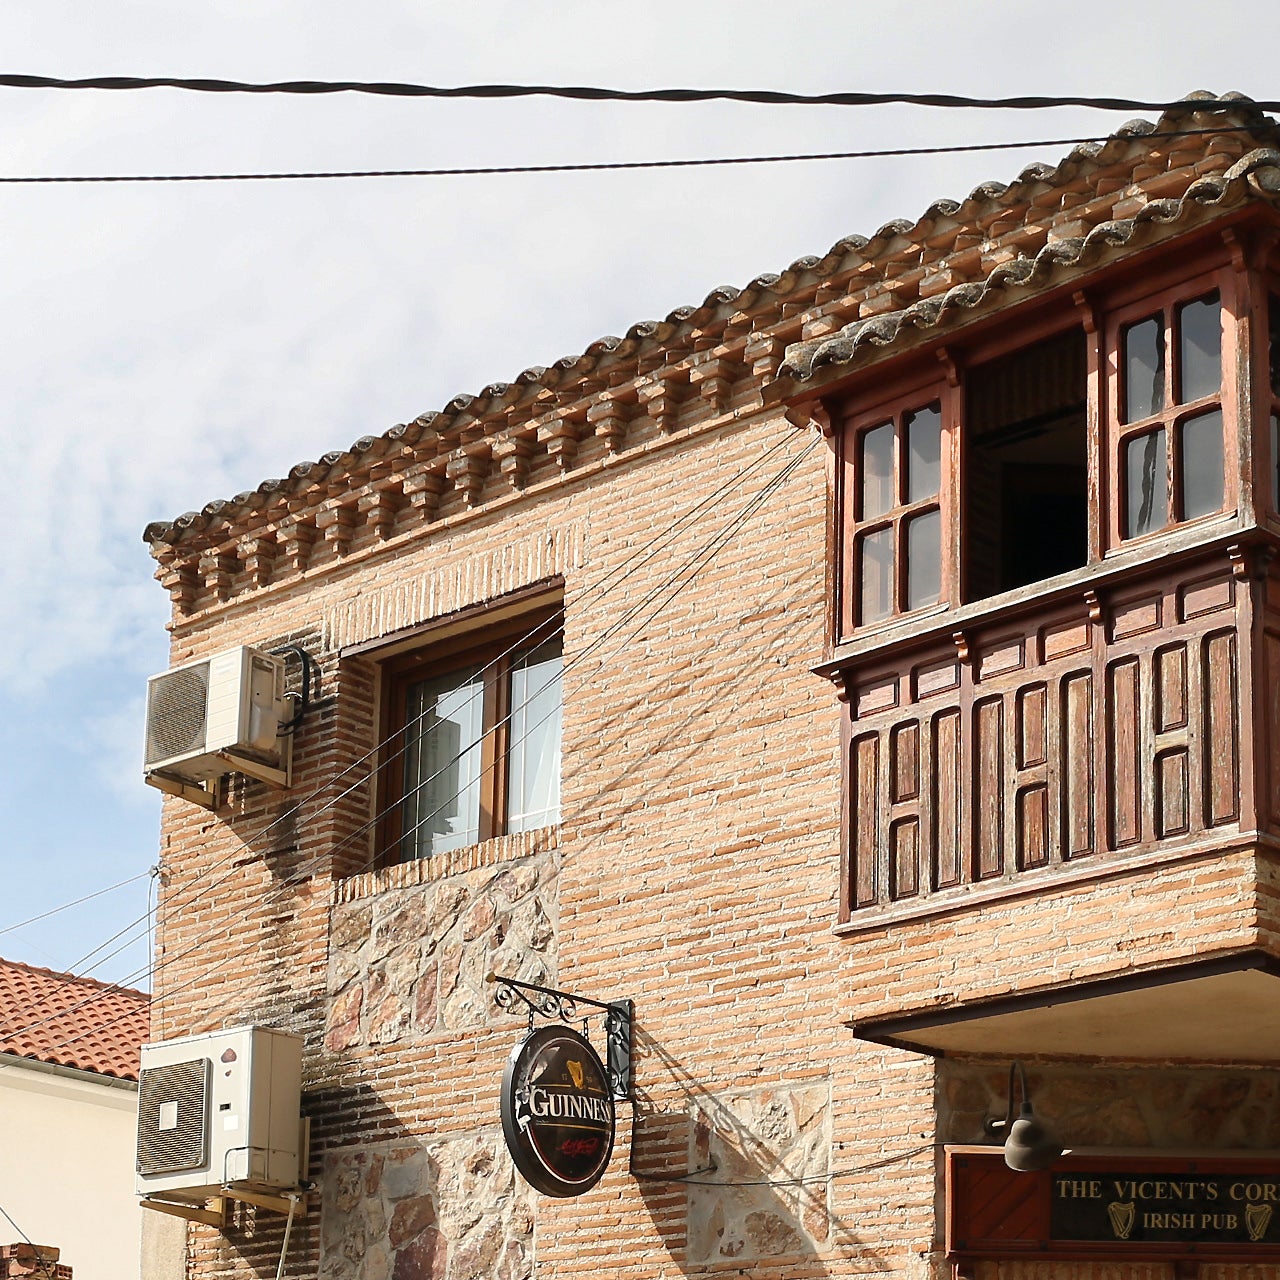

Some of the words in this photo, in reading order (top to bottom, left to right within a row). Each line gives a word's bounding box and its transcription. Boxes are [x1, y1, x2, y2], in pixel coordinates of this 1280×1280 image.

[529, 1086, 612, 1124] GUINNESS
[1057, 1180, 1102, 1198] THE
[1115, 1181, 1218, 1200] VICENT'S
[1143, 1213, 1195, 1229] IRISH
[1201, 1214, 1238, 1230] PUB
